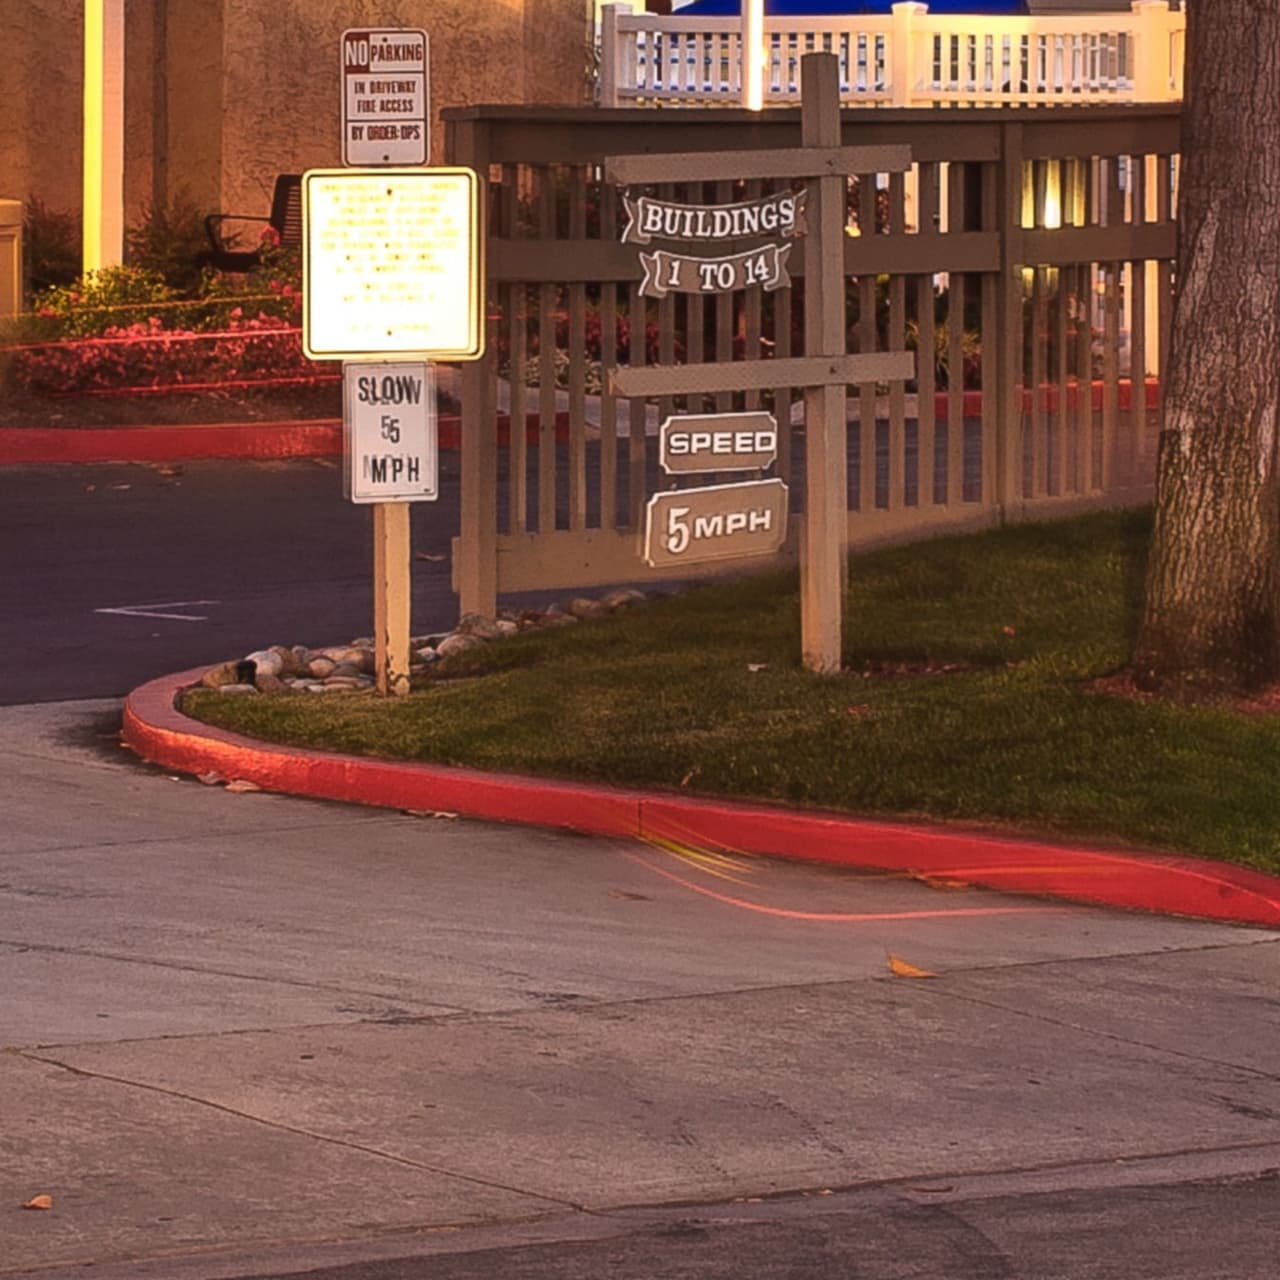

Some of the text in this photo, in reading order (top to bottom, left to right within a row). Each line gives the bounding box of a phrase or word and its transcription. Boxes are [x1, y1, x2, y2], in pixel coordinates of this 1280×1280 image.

[345, 40, 423, 67] NO PARKING
[379, 99, 414, 113] ACCESS
[351, 125, 364, 141] BY
[643, 199, 795, 238] BUILDINGS
[668, 255, 770, 290] 1 TO 14
[358, 375, 421, 405] SLOW
[669, 431, 777, 454] SPEED
[370, 456, 420, 484] MPH
[667, 507, 772, 553] 5 MPH
